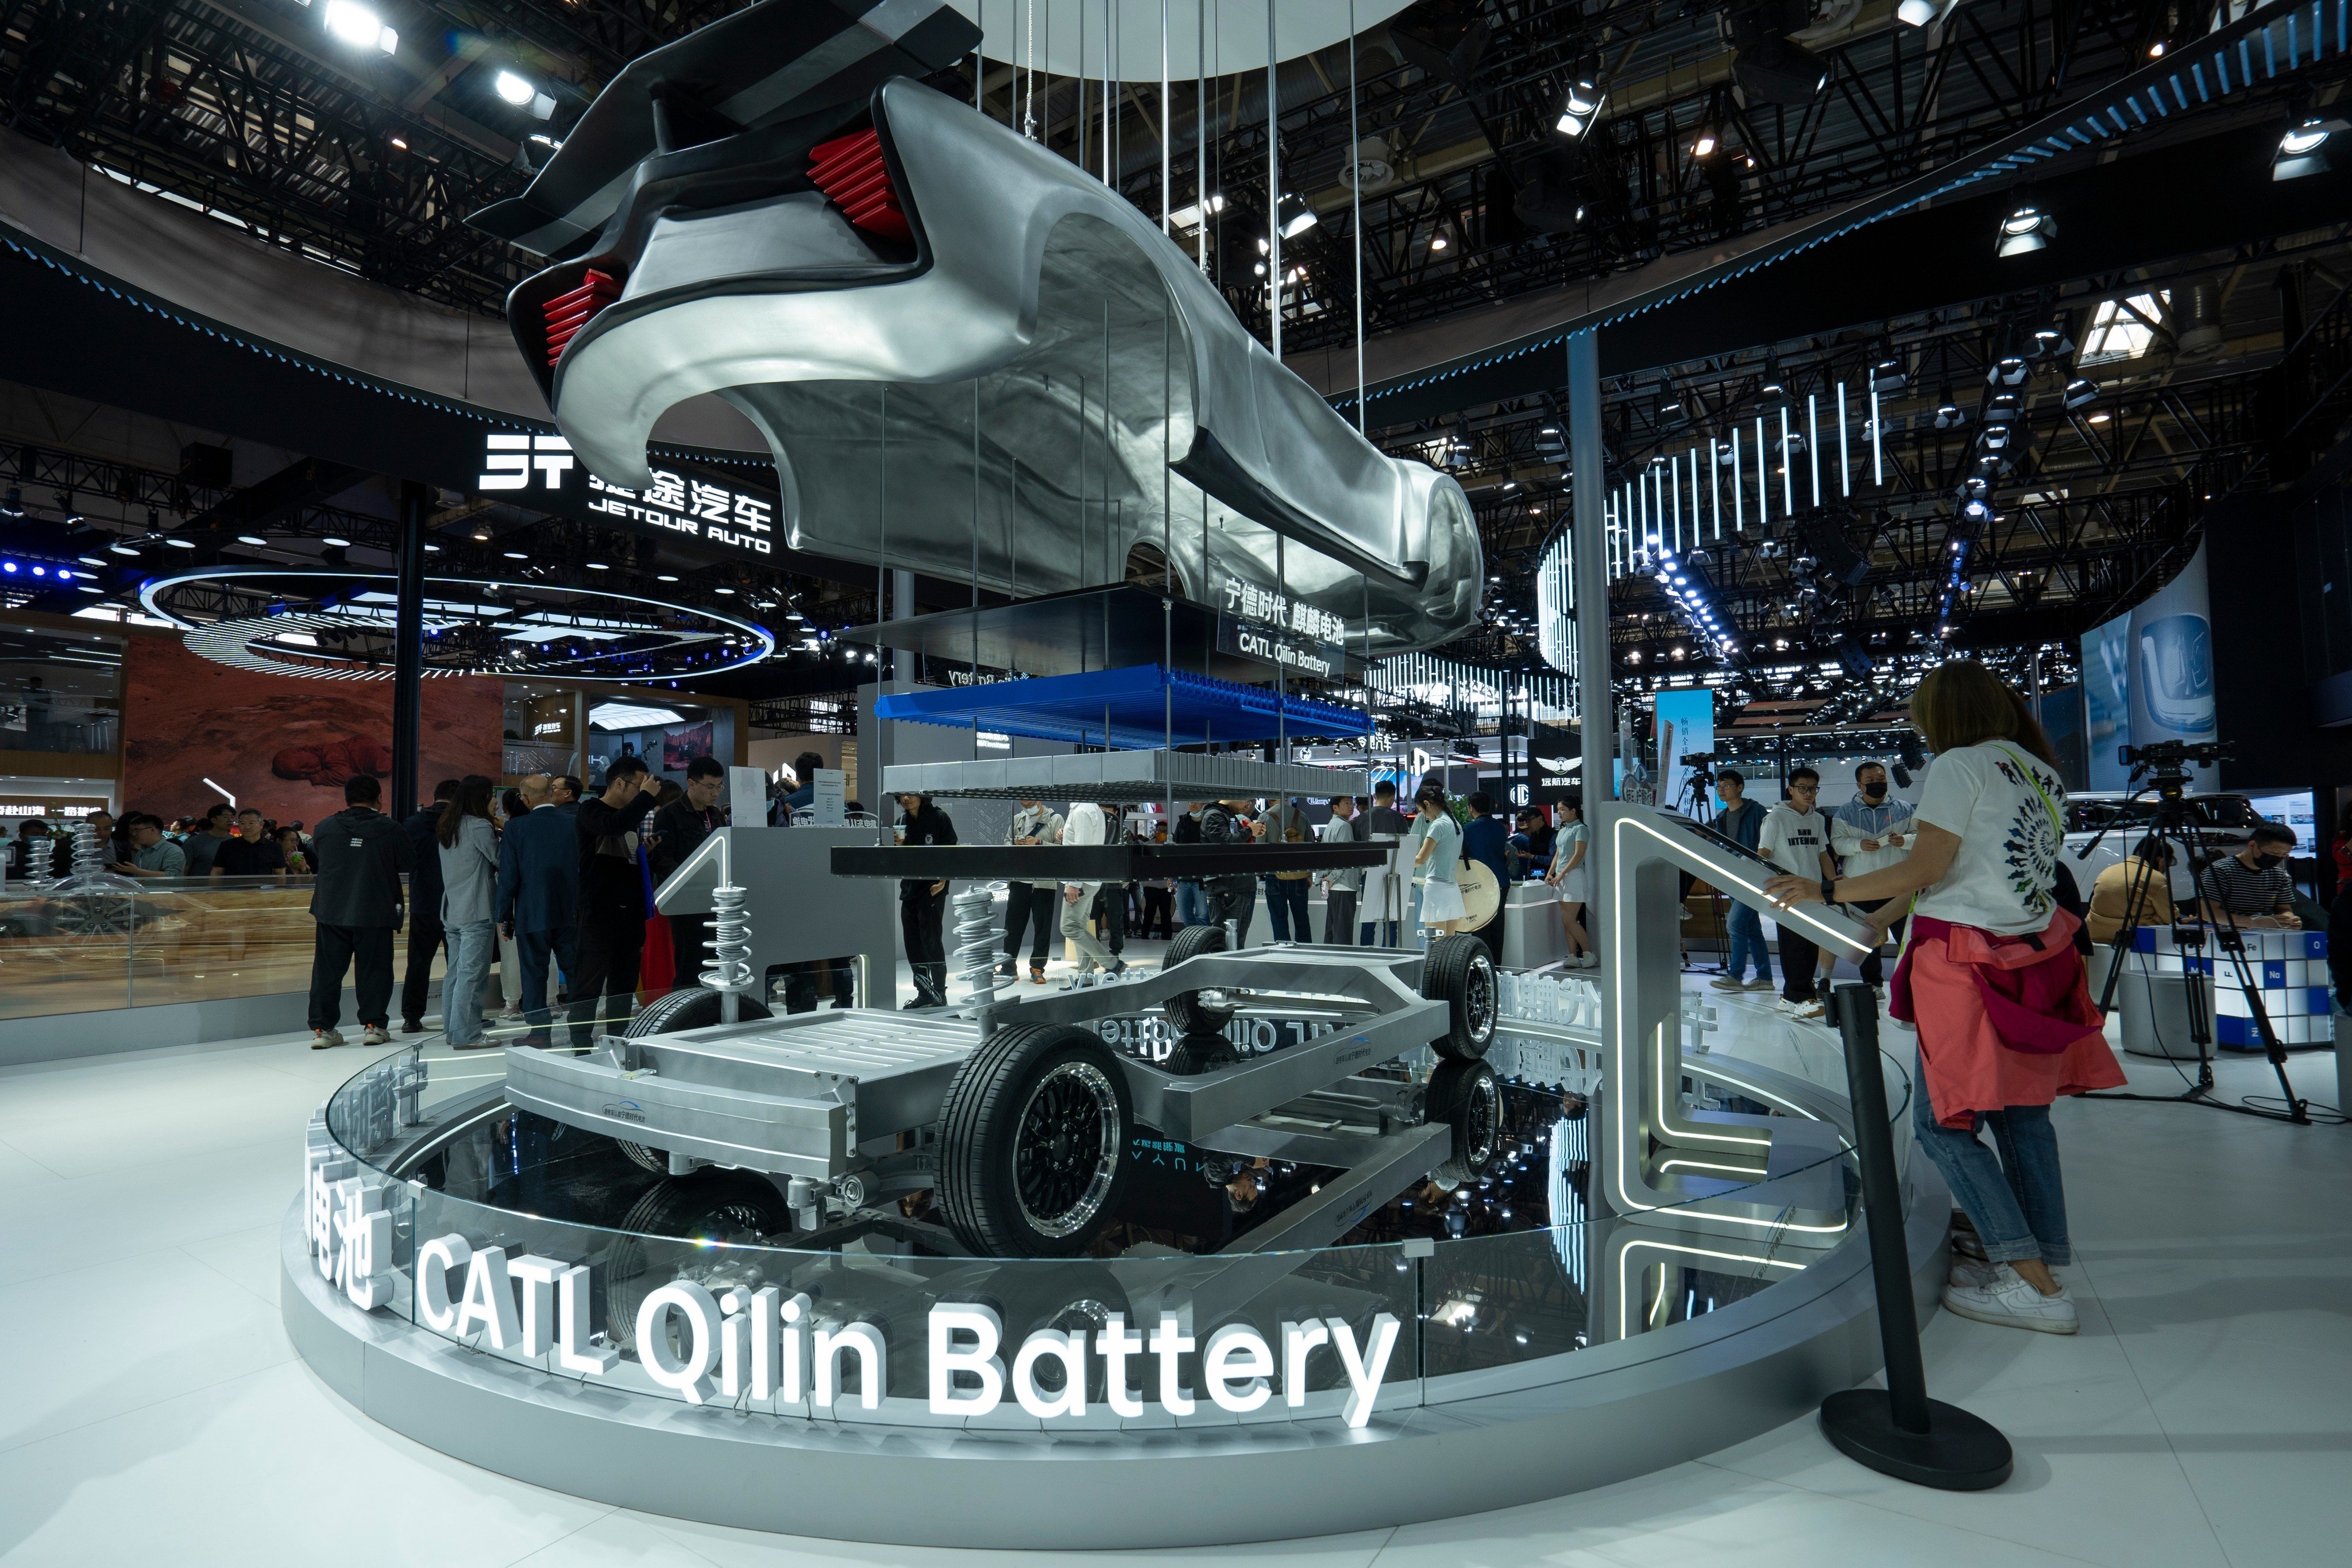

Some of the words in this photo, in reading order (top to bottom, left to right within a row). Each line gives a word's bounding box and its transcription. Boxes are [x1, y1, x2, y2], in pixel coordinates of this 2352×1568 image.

[588, 497, 698, 535] JETOUR
[708, 526, 771, 554] AUTO
[1225, 577, 1287, 627] 宁德时代
[1292, 601, 1345, 646] 麒麟电池
[1239, 633, 1273, 659] CATL
[1274, 643, 1296, 663] Qilin
[1297, 650, 1331, 678] Battery
[1542, 778, 1581, 786] 远航汽车
[2247, 943, 2257, 951] Fe
[2269, 971, 2280, 979] Na
[416, 1234, 615, 1376] CATL
[635, 1280, 885, 1410] Qilin
[928, 1303, 1400, 1428] Battery
